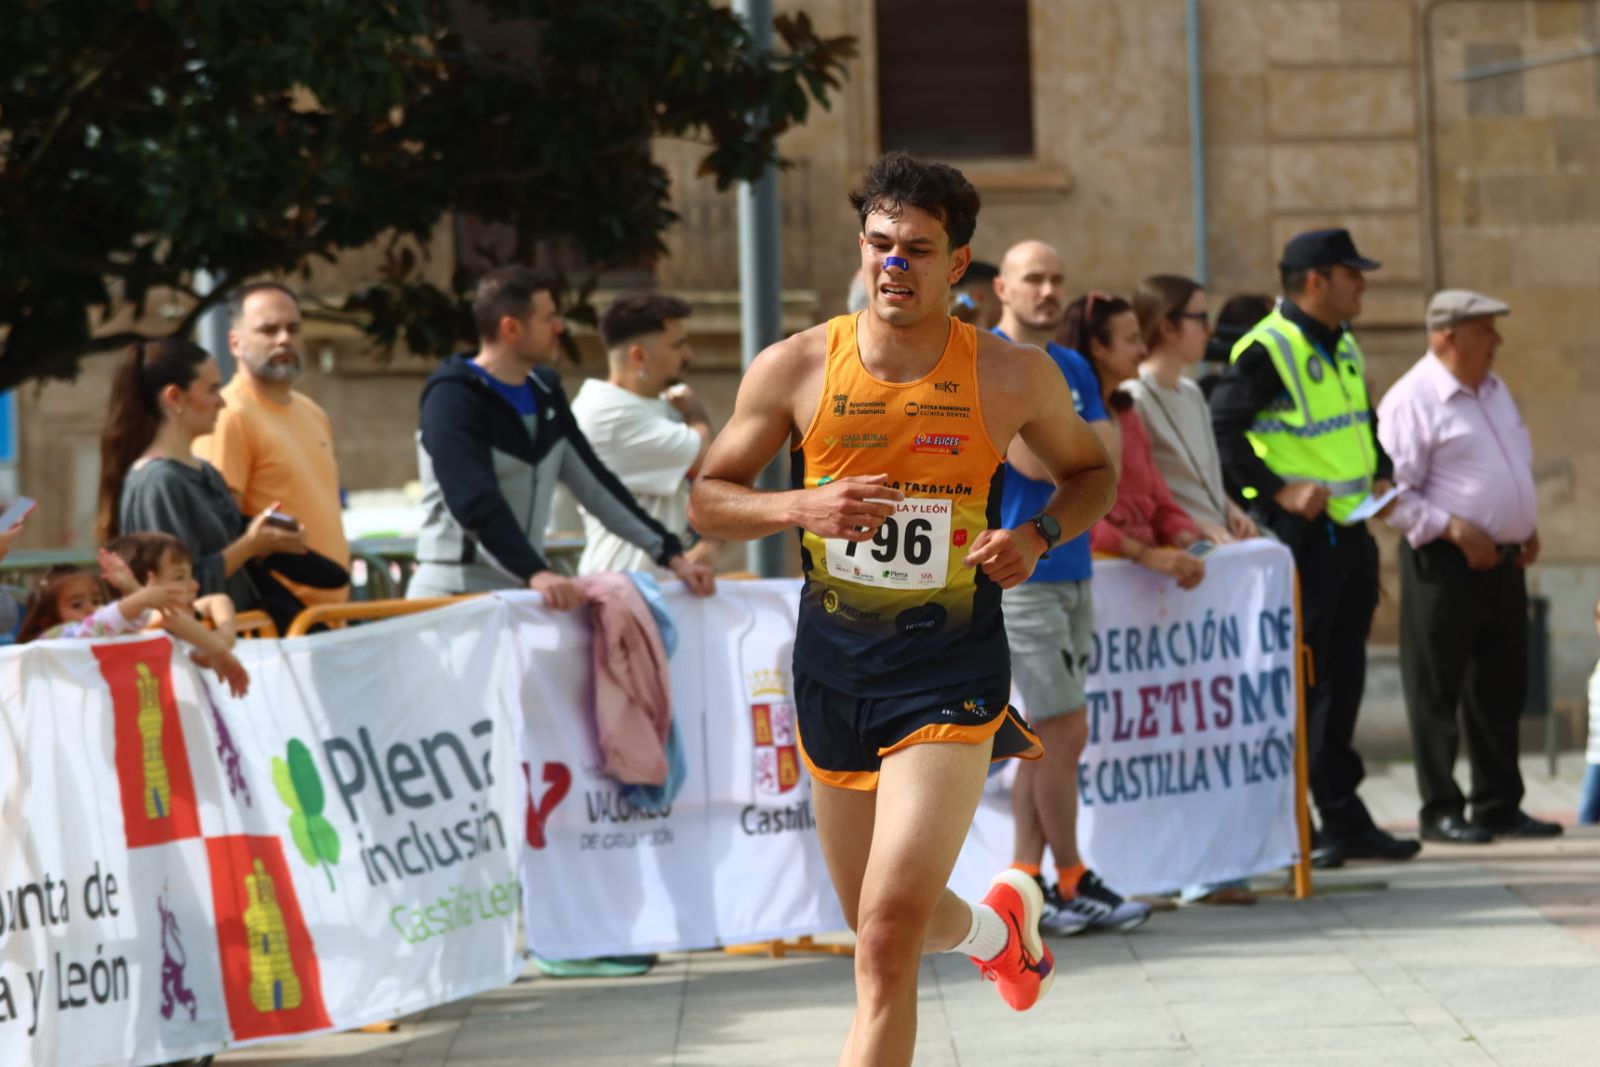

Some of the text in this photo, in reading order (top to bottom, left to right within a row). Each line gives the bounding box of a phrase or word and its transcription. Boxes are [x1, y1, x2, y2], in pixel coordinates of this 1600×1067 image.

[912, 505, 918, 513] Y
[920, 503, 948, 513] LEÓN
[1096, 751, 1209, 805] CASTILLA
[1213, 744, 1231, 789] Y
[84, 861, 120, 920] de
[26, 970, 44, 1037] y
[55, 944, 130, 1011] León
